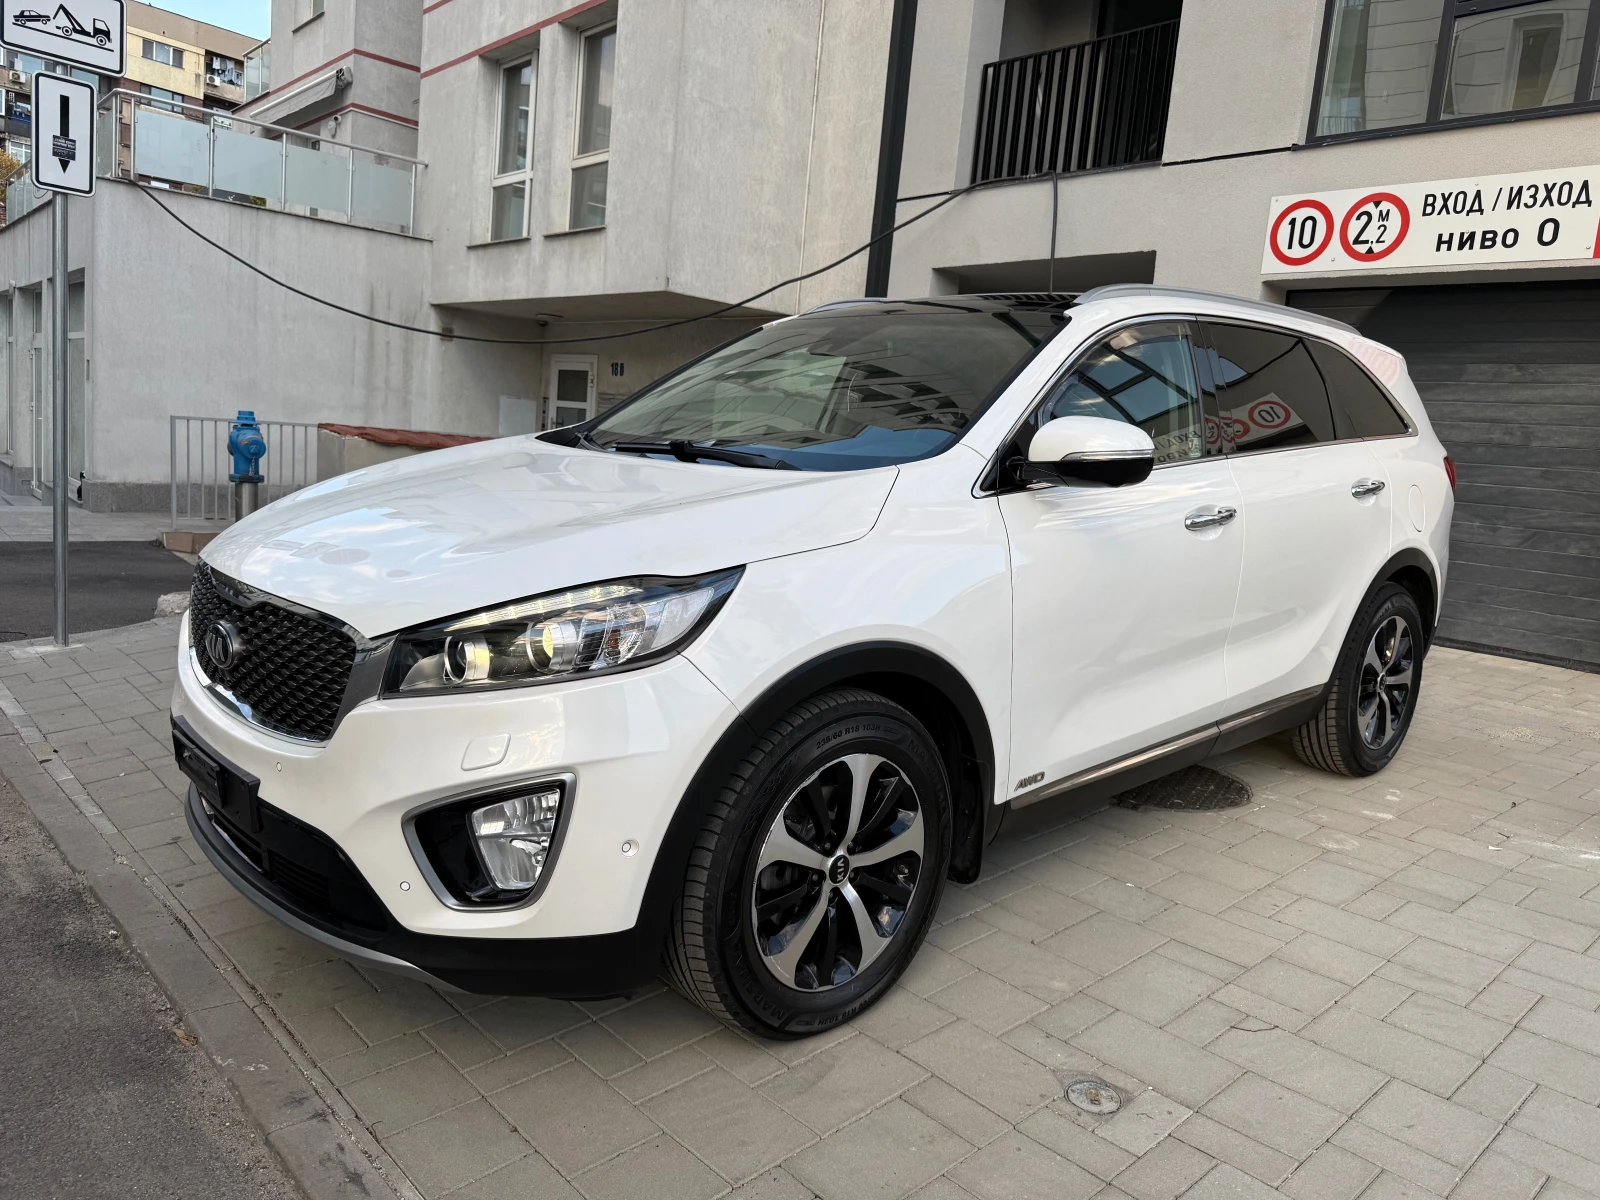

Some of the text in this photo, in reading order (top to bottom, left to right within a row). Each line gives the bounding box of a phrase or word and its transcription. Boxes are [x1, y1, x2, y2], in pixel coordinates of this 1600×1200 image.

[1422, 189, 1484, 217] ВХОД
[1506, 179, 1592, 210] ИЗХОД
[1287, 215, 1317, 250] 10
[844, 724, 860, 735] R18
[1013, 771, 1045, 792] AWD
[836, 858, 845, 882] KIA
